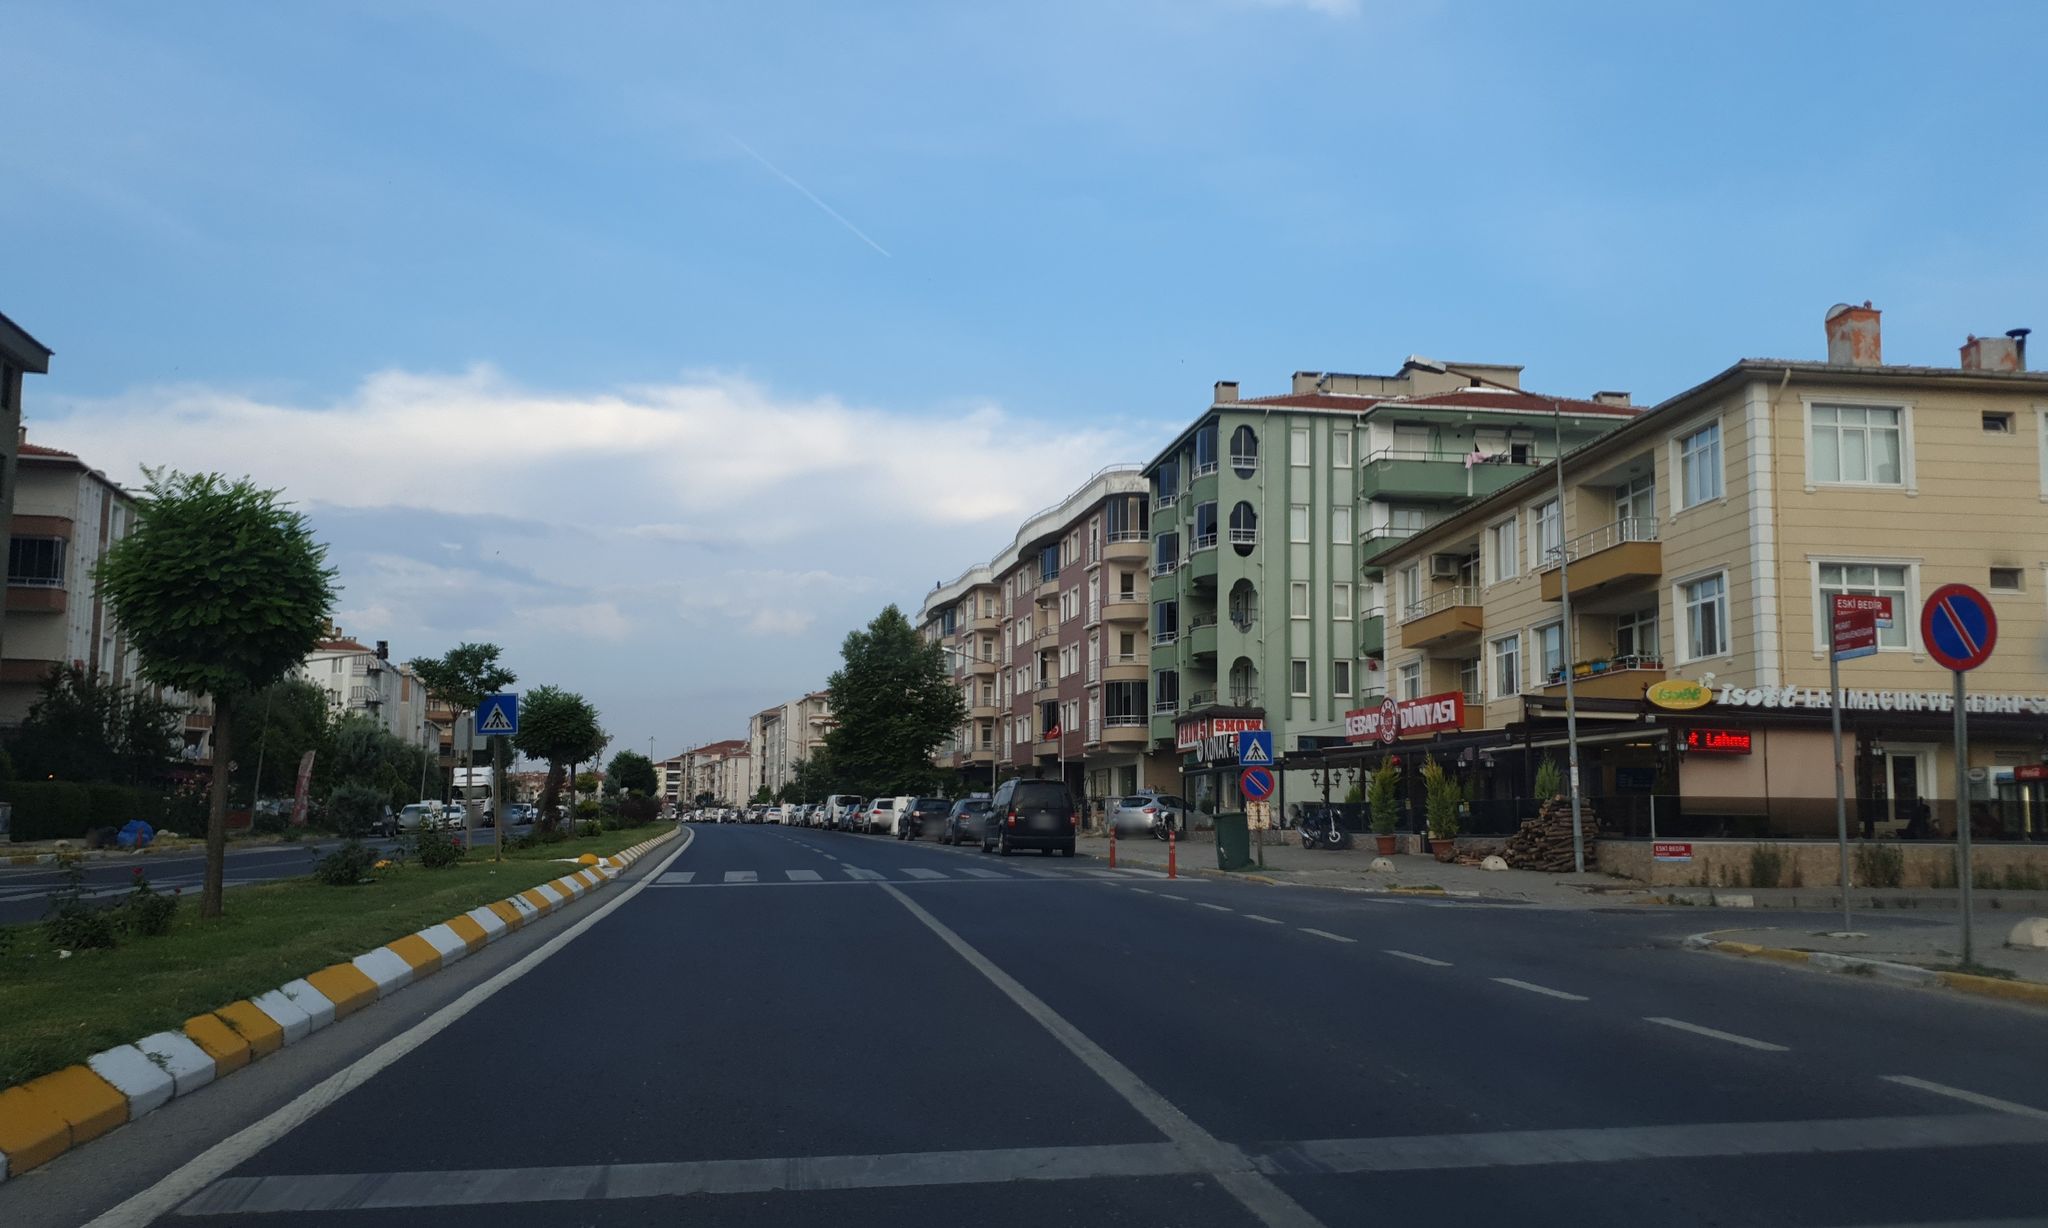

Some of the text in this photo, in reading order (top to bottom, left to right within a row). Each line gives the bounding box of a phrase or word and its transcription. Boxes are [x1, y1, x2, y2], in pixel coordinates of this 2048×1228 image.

[1837, 597, 1882, 610] ESKİ BEDİR
[1215, 719, 1262, 732] SHOW
[1345, 713, 1380, 737] KEBAP
[1401, 700, 1456, 729] DÜNYASI
[1204, 734, 1229, 761] KONAK
